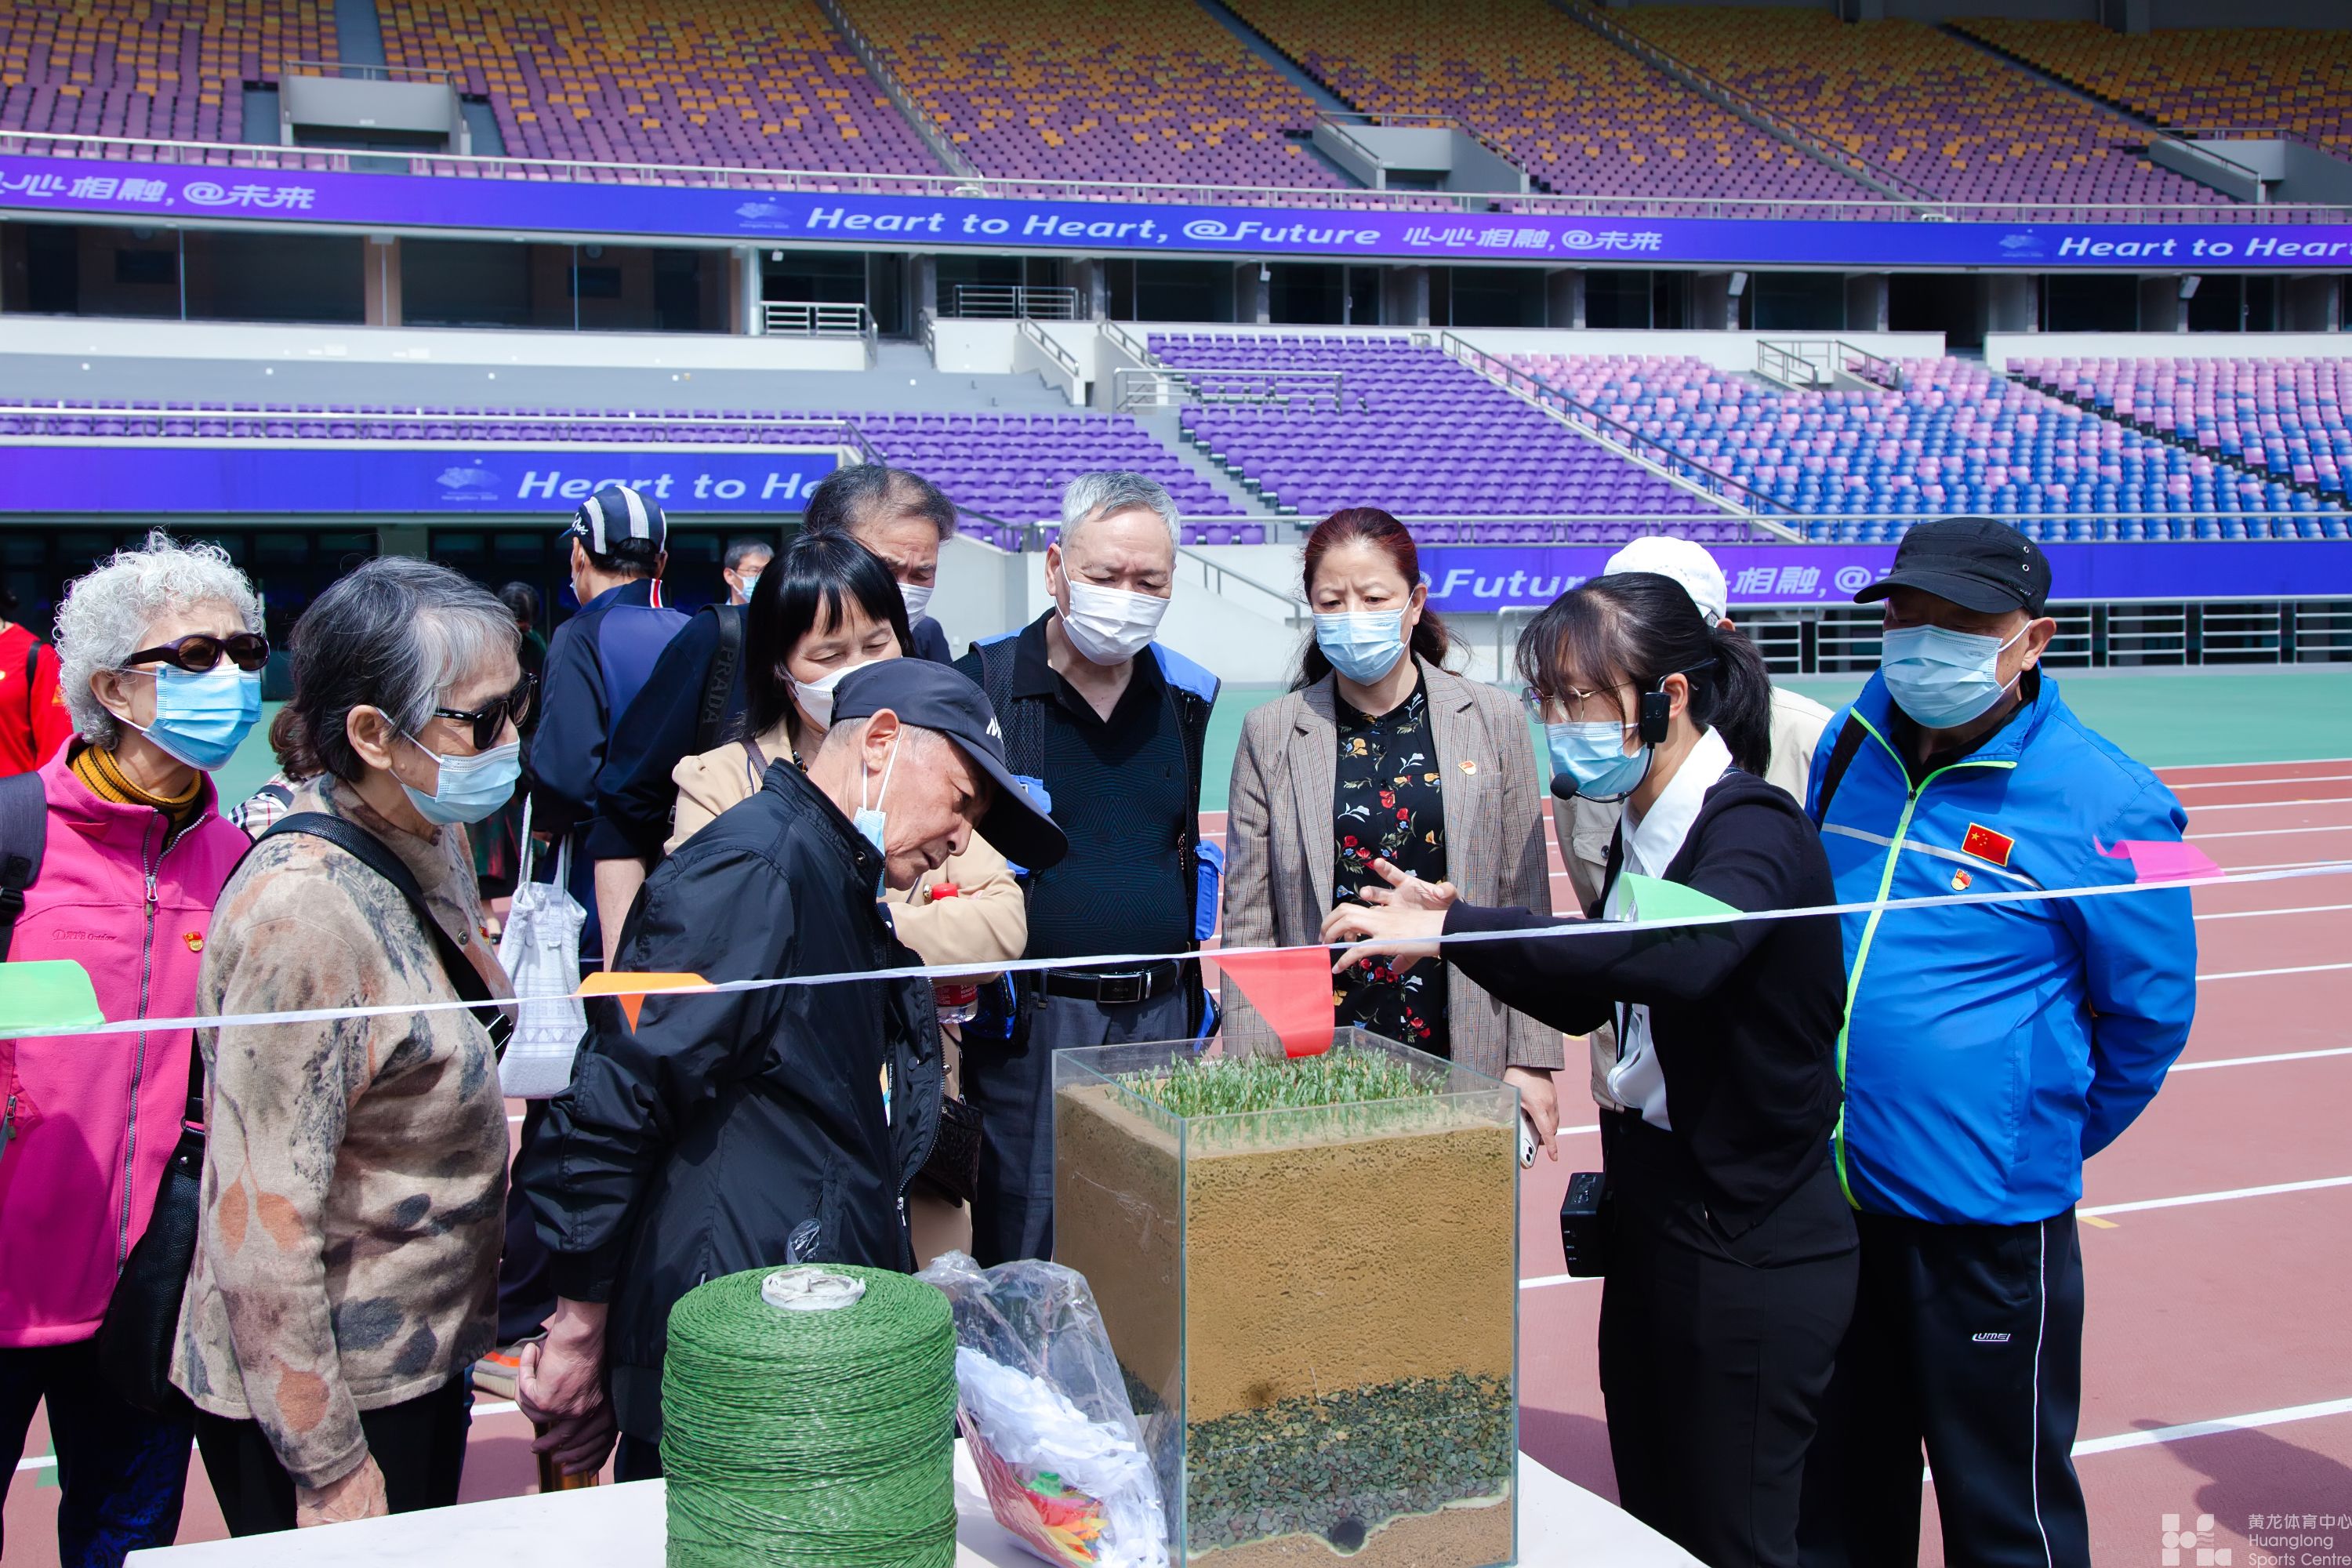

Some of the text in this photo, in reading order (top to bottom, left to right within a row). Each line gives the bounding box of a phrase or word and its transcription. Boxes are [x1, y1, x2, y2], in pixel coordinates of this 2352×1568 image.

[806, 207, 1381, 245] Heart to Heart, @Future
[2058, 238, 2352, 257] Heart to Hear
[693, 474, 747, 499] to
[702, 646, 735, 724] PRADA
